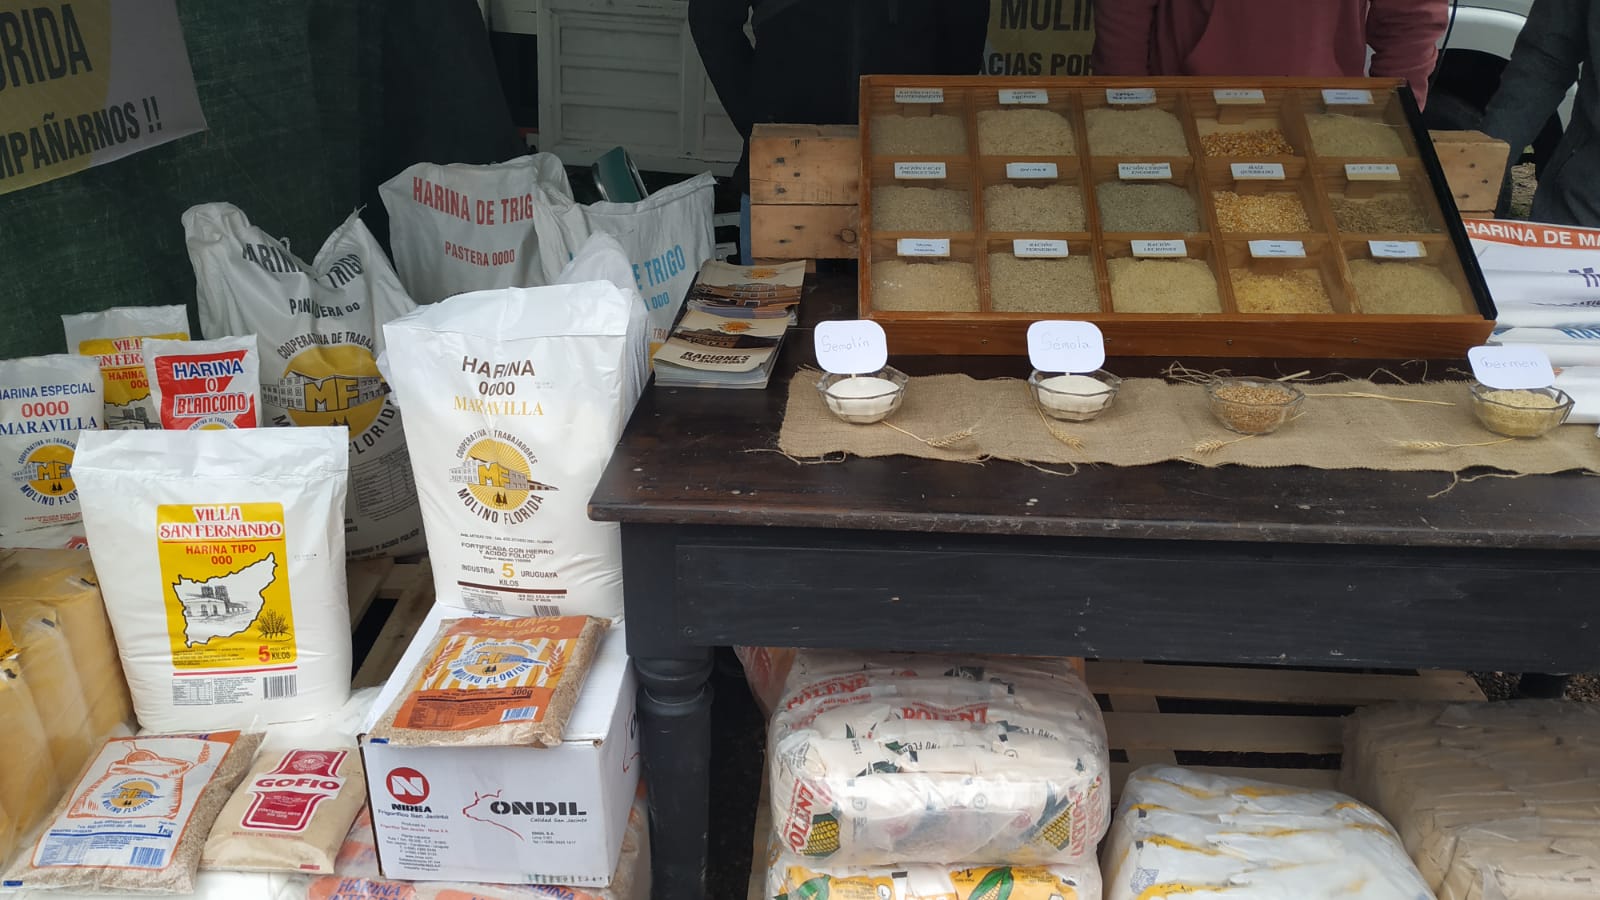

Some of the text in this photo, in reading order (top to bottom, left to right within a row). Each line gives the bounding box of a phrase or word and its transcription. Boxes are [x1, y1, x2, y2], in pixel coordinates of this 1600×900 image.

[0, 3, 94, 93] RIDA
[412, 176, 534, 226] HARINA DE TRIG
[1463, 220, 1537, 243] HARINA
[1543, 229, 1573, 246] DE
[445, 240, 516, 267] PASTERA 0000
[645, 244, 687, 287] TRIGO
[651, 291, 671, 310] 000
[113, 339, 143, 352] VILL
[277, 332, 329, 360] COOPERATIVA
[331, 332, 344, 344] DE
[682, 351, 752, 363] RACIONES
[108, 372, 145, 381] HARINA
[173, 359, 244, 379] HARINA
[462, 355, 536, 380] HARINA
[0, 382, 96, 401] ARINA ESPECIAL
[478, 381, 516, 397] 0000
[21, 400, 70, 418] 0000
[176, 393, 247, 415] BLANCONO
[453, 395, 545, 417] MARAVILLA
[0, 415, 98, 436] MARAVILLA
[455, 428, 539, 466] COOPERATIVA TRABAJADORES
[20, 483, 55, 506] MOLINO
[194, 507, 242, 522] VILLA
[456, 487, 500, 524] MOLINO
[503, 494, 546, 525] FLORIDA
[159, 522, 283, 539] SAN FERNANDO
[185, 544, 257, 555] HARINA TIPO
[211, 555, 233, 565] 000
[461, 562, 558, 579] INDUSTRIA 5 URUGUAYA
[499, 579, 520, 587] KILOS
[257, 645, 271, 663] 5
[486, 662, 534, 685] FLORIDA
[255, 777, 341, 791] GOFIO
[489, 800, 588, 817] ONDIL
[337, 879, 401, 897] HARINA
